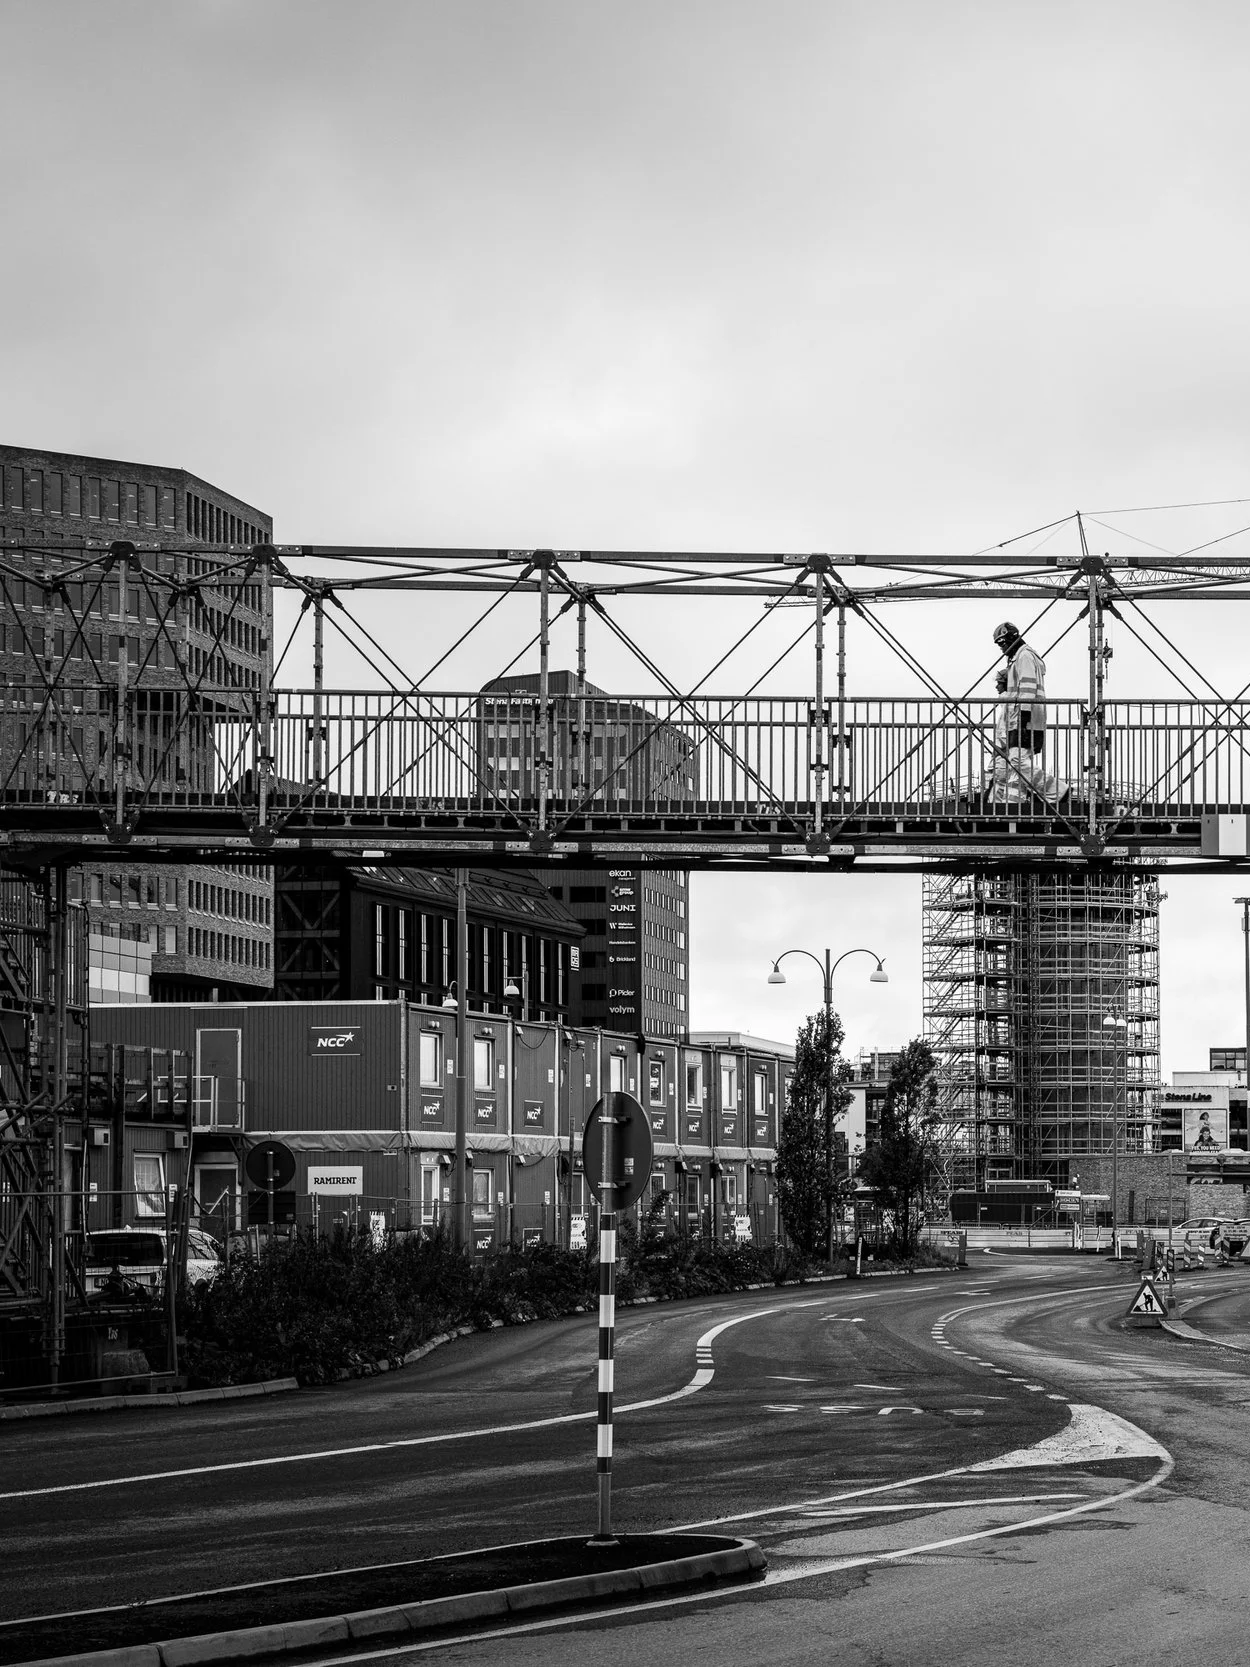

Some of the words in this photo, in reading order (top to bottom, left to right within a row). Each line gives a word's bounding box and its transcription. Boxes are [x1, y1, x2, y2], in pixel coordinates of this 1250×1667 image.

[608, 869, 632, 877] ekan
[609, 904, 636, 912] JUNI
[609, 1005, 635, 1014] volym
[316, 1037, 345, 1047] NCC
[1165, 1092, 1191, 1101] Stena
[1192, 1092, 1213, 1101] Line
[313, 1177, 357, 1185] RAMIRENT
[476, 1240, 489, 1249] NCC
